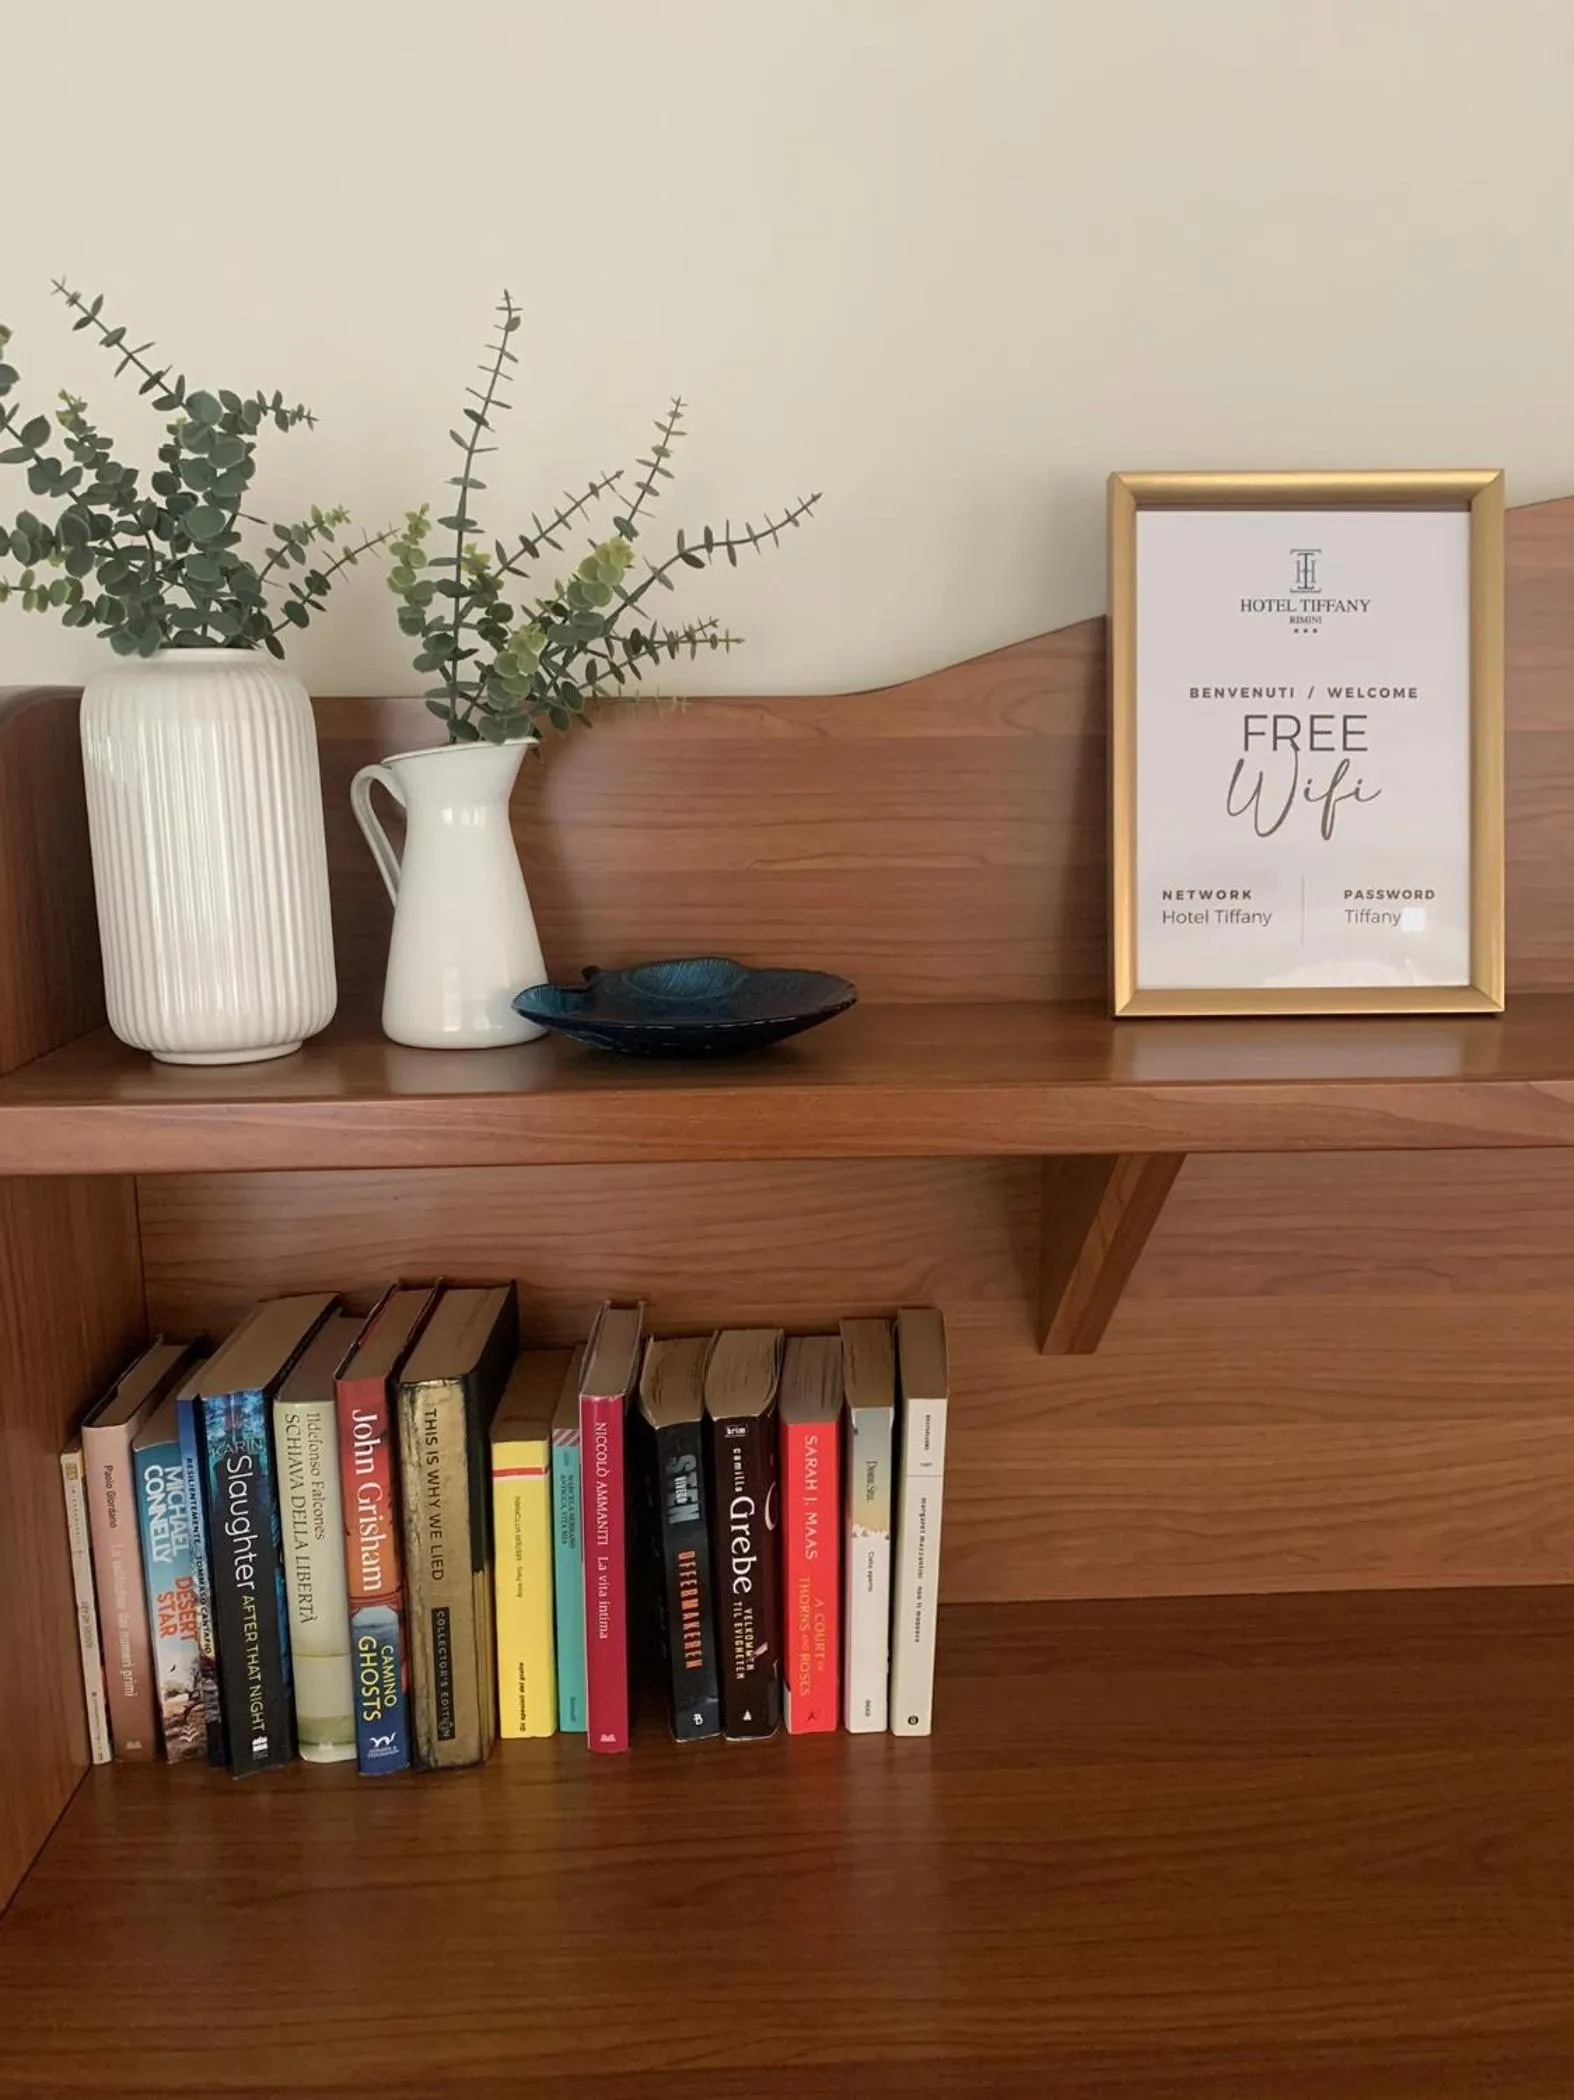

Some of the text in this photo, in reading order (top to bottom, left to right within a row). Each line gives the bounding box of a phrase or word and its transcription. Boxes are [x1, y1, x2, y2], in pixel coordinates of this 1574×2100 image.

[1240, 599, 1371, 613] HOTEL TIFFANY
[1289, 616, 1322, 624] RIMINI
[1190, 687, 1295, 699] BENVENUTI
[1327, 687, 1419, 699] WELCOME
[1243, 714, 1368, 752] FREE
[1226, 742, 1382, 841] Wifi
[1162, 888, 1253, 900] NETWORK
[1162, 909, 1272, 928] Hotel Tiffany
[1344, 889, 1435, 900] PASSWORD
[210, 1437, 263, 1457] KARIN
[804, 1435, 818, 1491] SARAH
[102, 1465, 117, 1528] Paolo Giordano
[186, 1457, 201, 1548] RESILIENTEMENTE
[307, 1412, 326, 1541] Ildefonso Falcones
[352, 1408, 387, 1592] John Grisham
[424, 1407, 445, 1581] THIS IS WHY WE LIED
[666, 1454, 700, 1523] STEN
[144, 1464, 173, 1563] CONNELLY
[165, 1466, 189, 1557] MICHAEL
[225, 1454, 259, 1590] Slaughter
[285, 1414, 318, 1624] SCHIAVA DELLA LIBERTÀ
[596, 1422, 611, 1639] NICCOLÒ AMMANITI La vita intima
[730, 1448, 756, 1594] camilla Grebe
[805, 1512, 818, 1561] MAAS
[157, 1591, 177, 1638] STAR
[175, 1576, 198, 1641] DESERT
[240, 1595, 258, 1643] AFTER
[678, 1550, 703, 1669] OFFERMAKEREN
[798, 1576, 811, 1631] THORNS
[814, 1597, 825, 1608] A
[245, 1643, 261, 1681] THAT
[733, 1602, 745, 1680] TIL EVIGHETEN
[814, 1613, 826, 1658] COURT
[120, 1670, 137, 1697] primi
[358, 1635, 382, 1721] GHOSTS
[380, 1645, 397, 1708] CAMINO
[799, 1653, 811, 1697] ROSES
[249, 1684, 265, 1731] NIGHT
